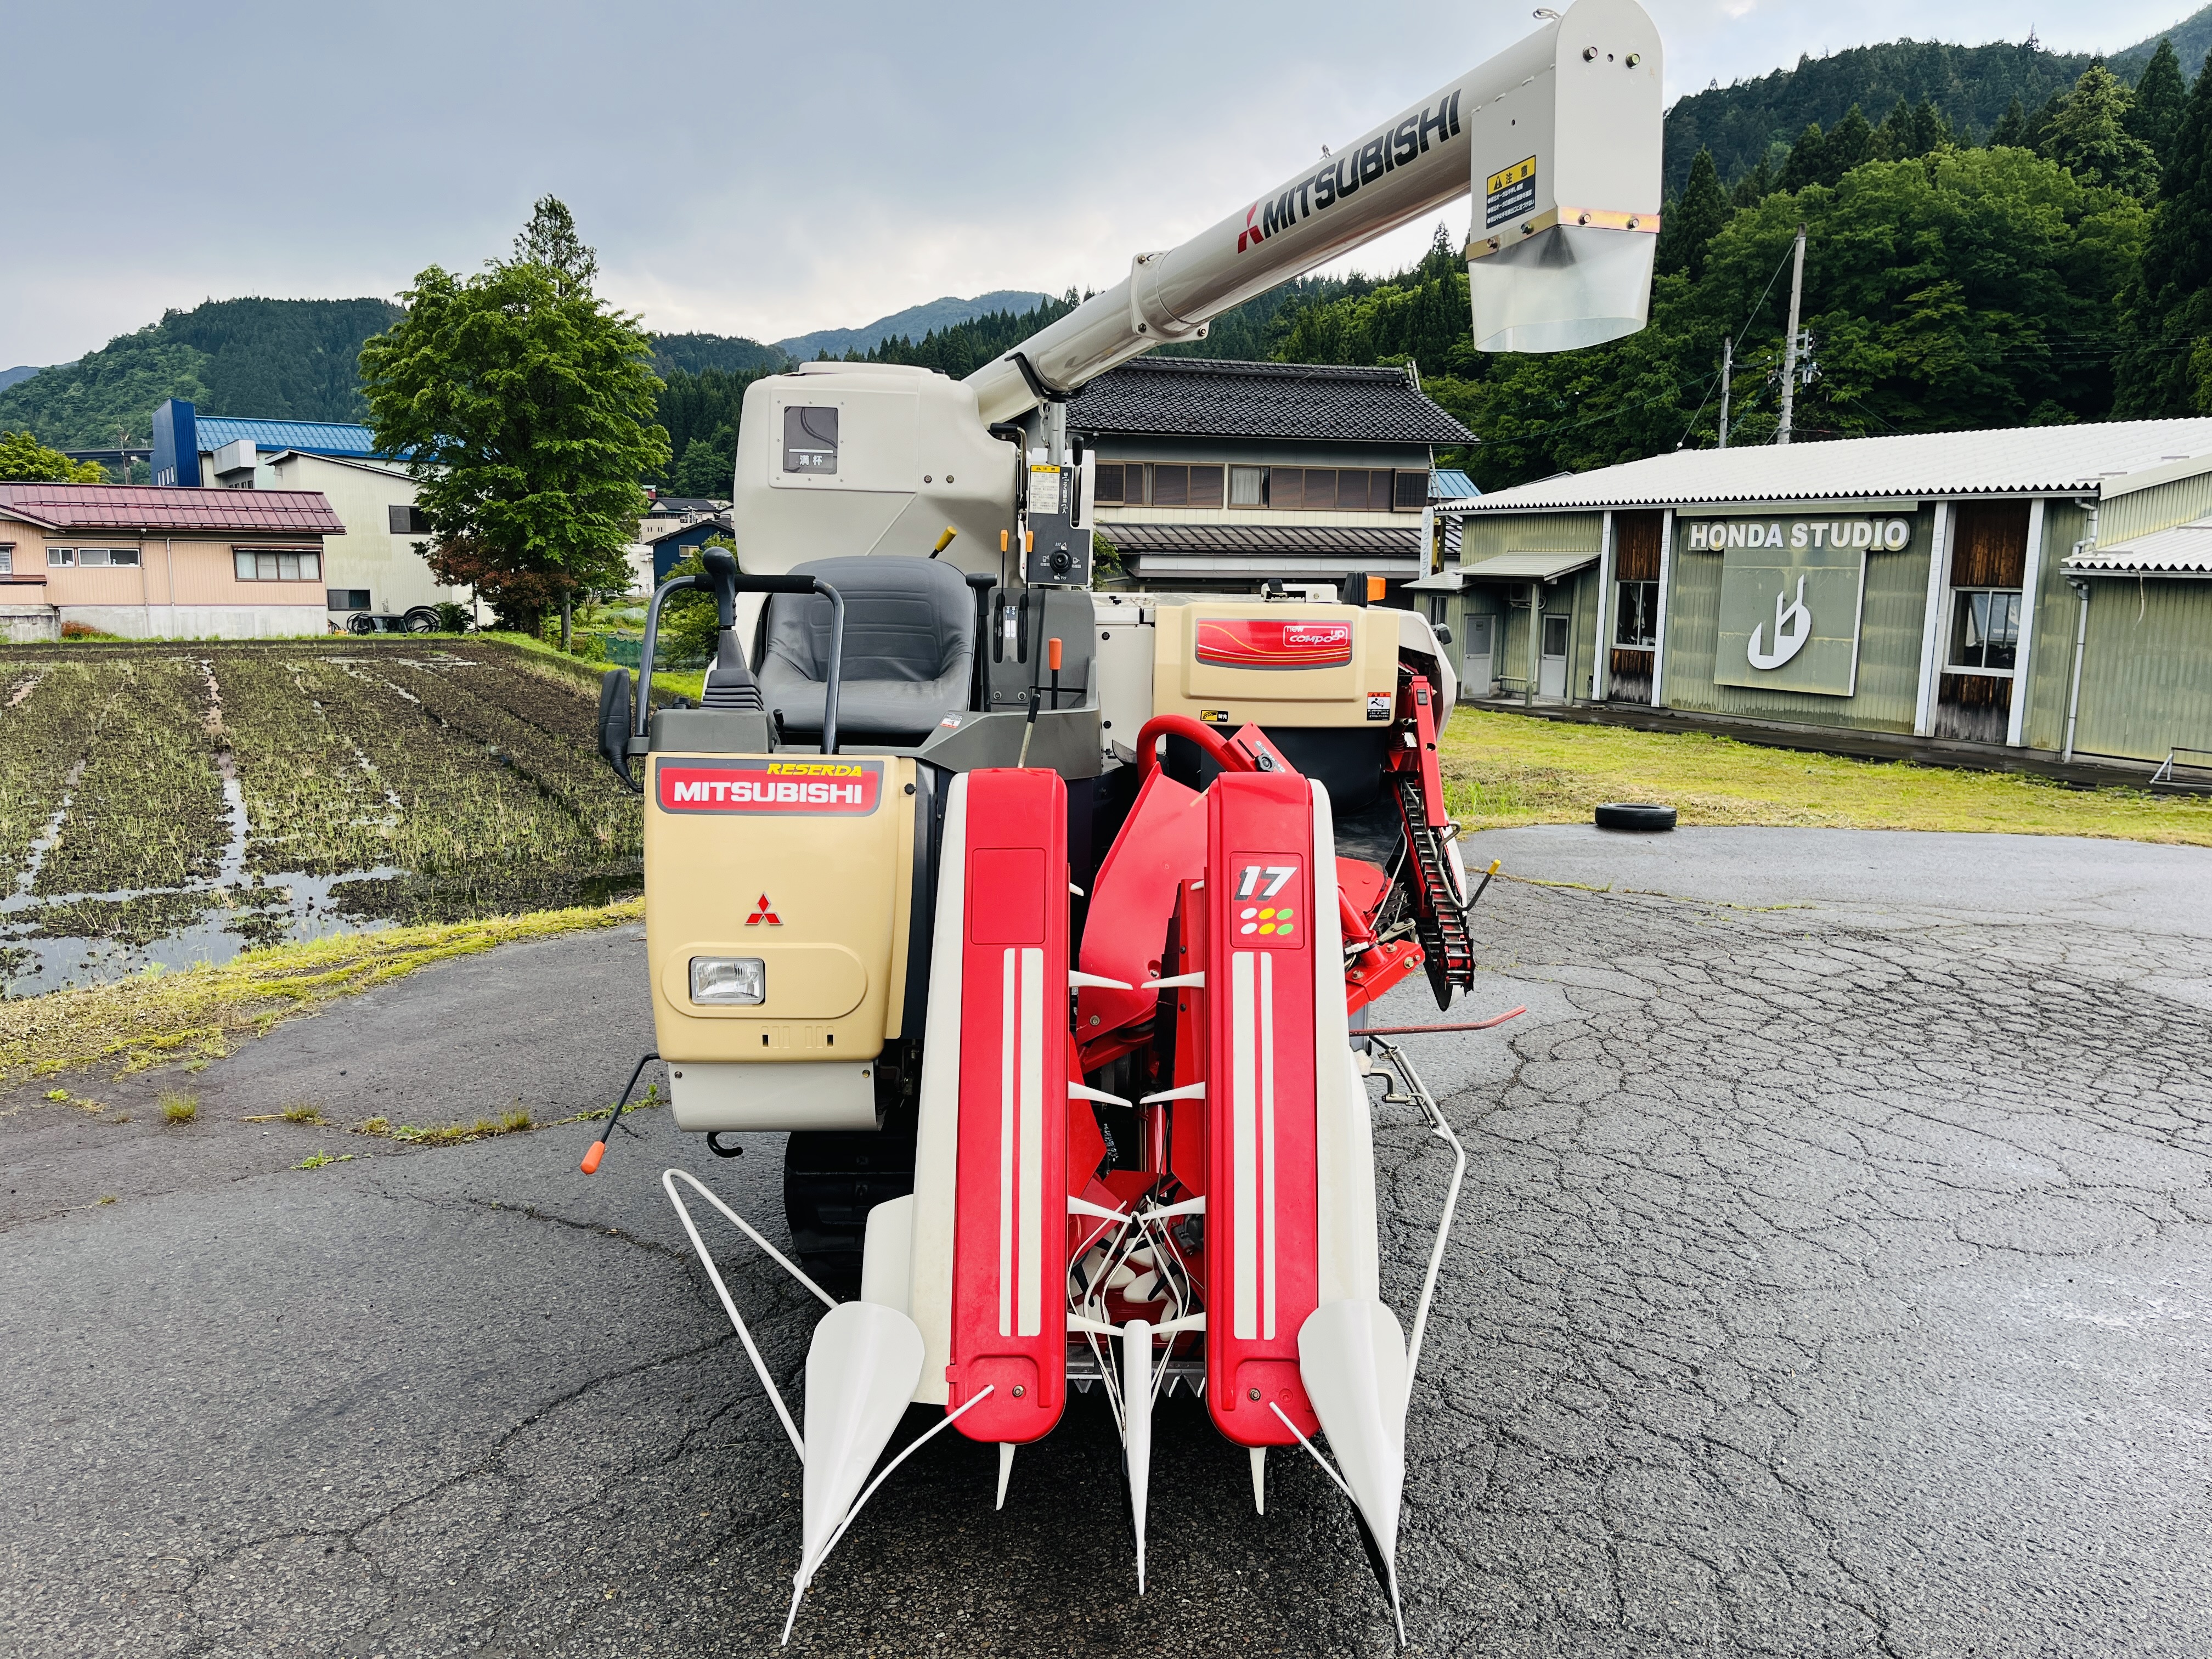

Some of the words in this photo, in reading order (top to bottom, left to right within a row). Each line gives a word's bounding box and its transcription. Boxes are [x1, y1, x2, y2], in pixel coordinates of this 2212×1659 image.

[1263, 88, 1462, 239] MITSUBISHI
[799, 455, 823, 466] 満杯
[1689, 522, 1784, 549] HONDA
[1790, 520, 1909, 549] STUDIO
[766, 763, 862, 777] RESERDA
[674, 781, 862, 804] MITSUBISHI
[1234, 866, 1298, 900] 17
